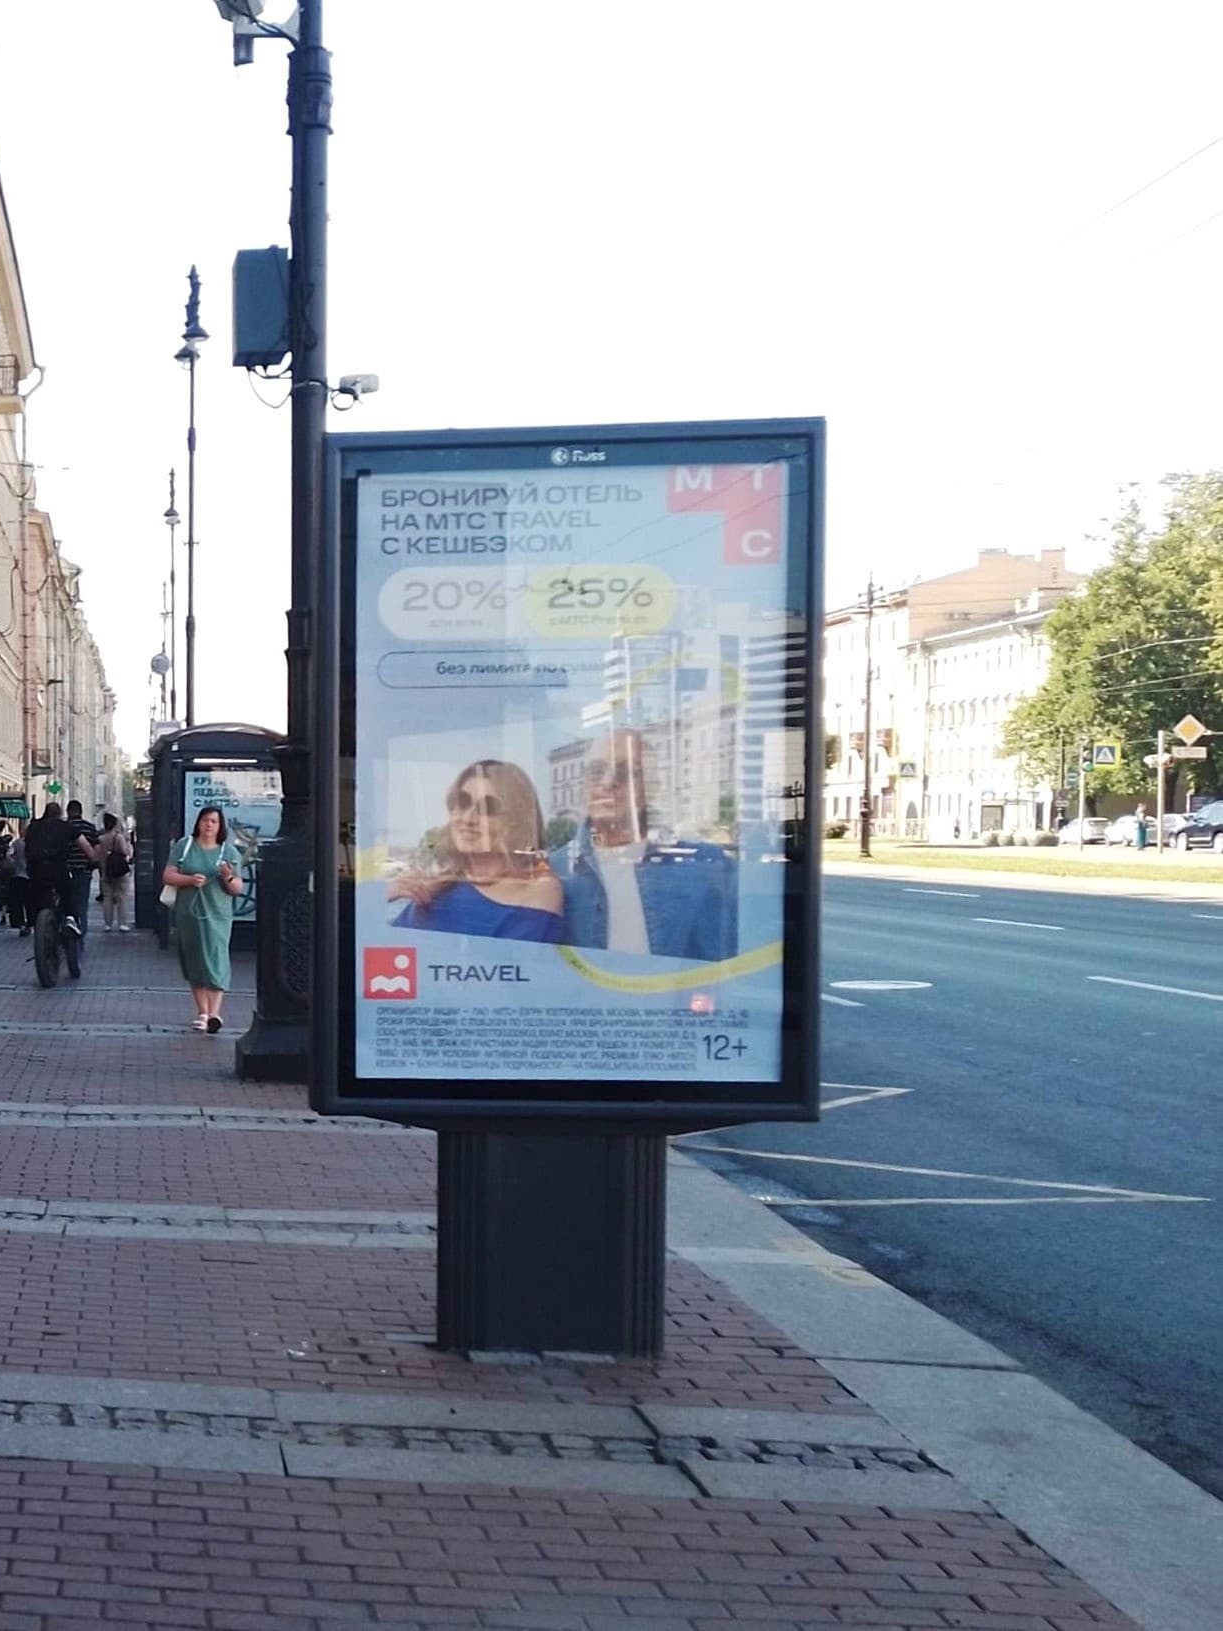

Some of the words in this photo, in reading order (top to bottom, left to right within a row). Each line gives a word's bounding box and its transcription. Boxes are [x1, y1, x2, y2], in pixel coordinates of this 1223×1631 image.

[381, 480, 538, 507] БРОНИРУЙ
[545, 485, 642, 505] ОТЕЛЬ
[381, 513, 419, 531] НА
[426, 512, 486, 530] МТС
[492, 510, 601, 529] TRAVEL
[380, 536, 399, 555] С
[406, 533, 573, 554] КЕШБЭКОМ
[402, 579, 509, 612] 20%
[547, 577, 654, 610] 25%
[436, 661, 464, 675] без
[428, 964, 531, 982] TRAVEL
[702, 1034, 748, 1061] 12+
